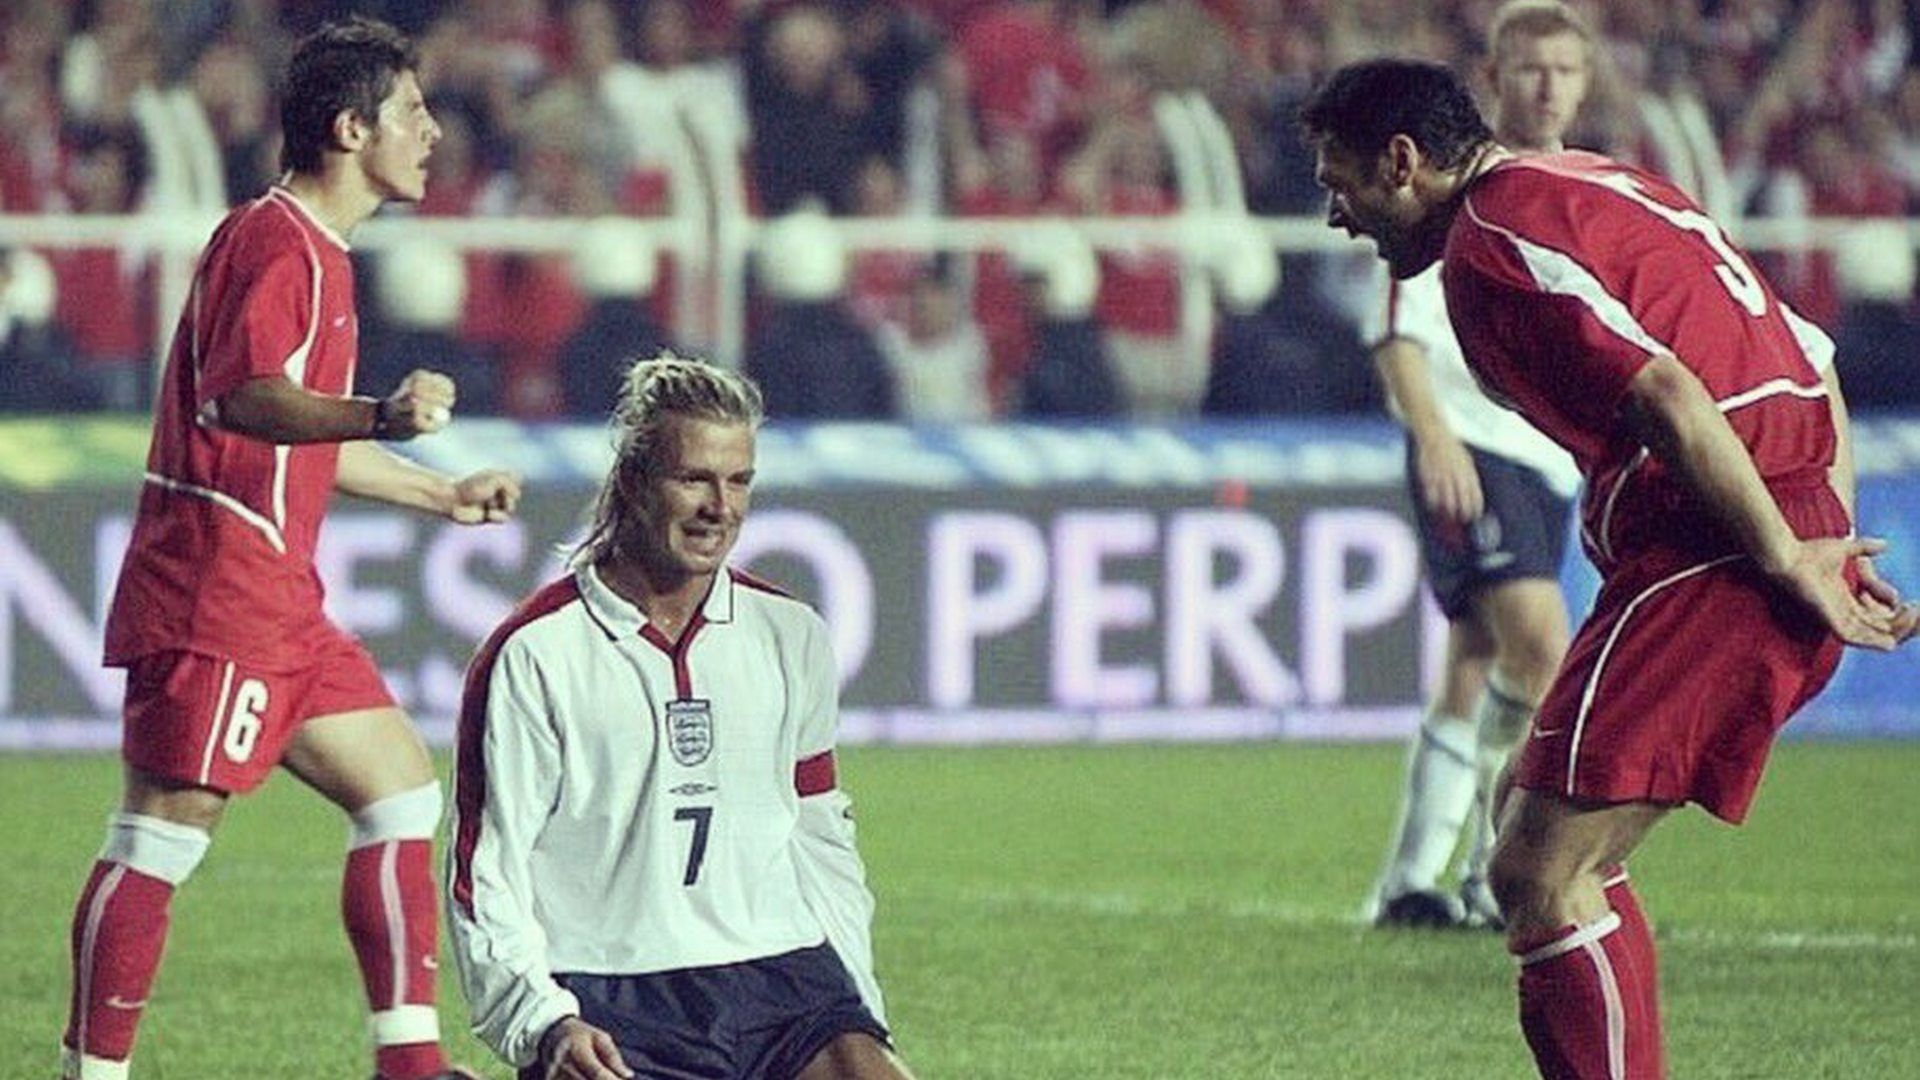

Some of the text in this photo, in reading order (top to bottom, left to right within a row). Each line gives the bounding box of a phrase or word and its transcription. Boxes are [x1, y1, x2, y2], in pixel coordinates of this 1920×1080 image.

[930, 511, 1440, 709] PERP
[223, 678, 269, 763] 6
[673, 806, 713, 886] 7
